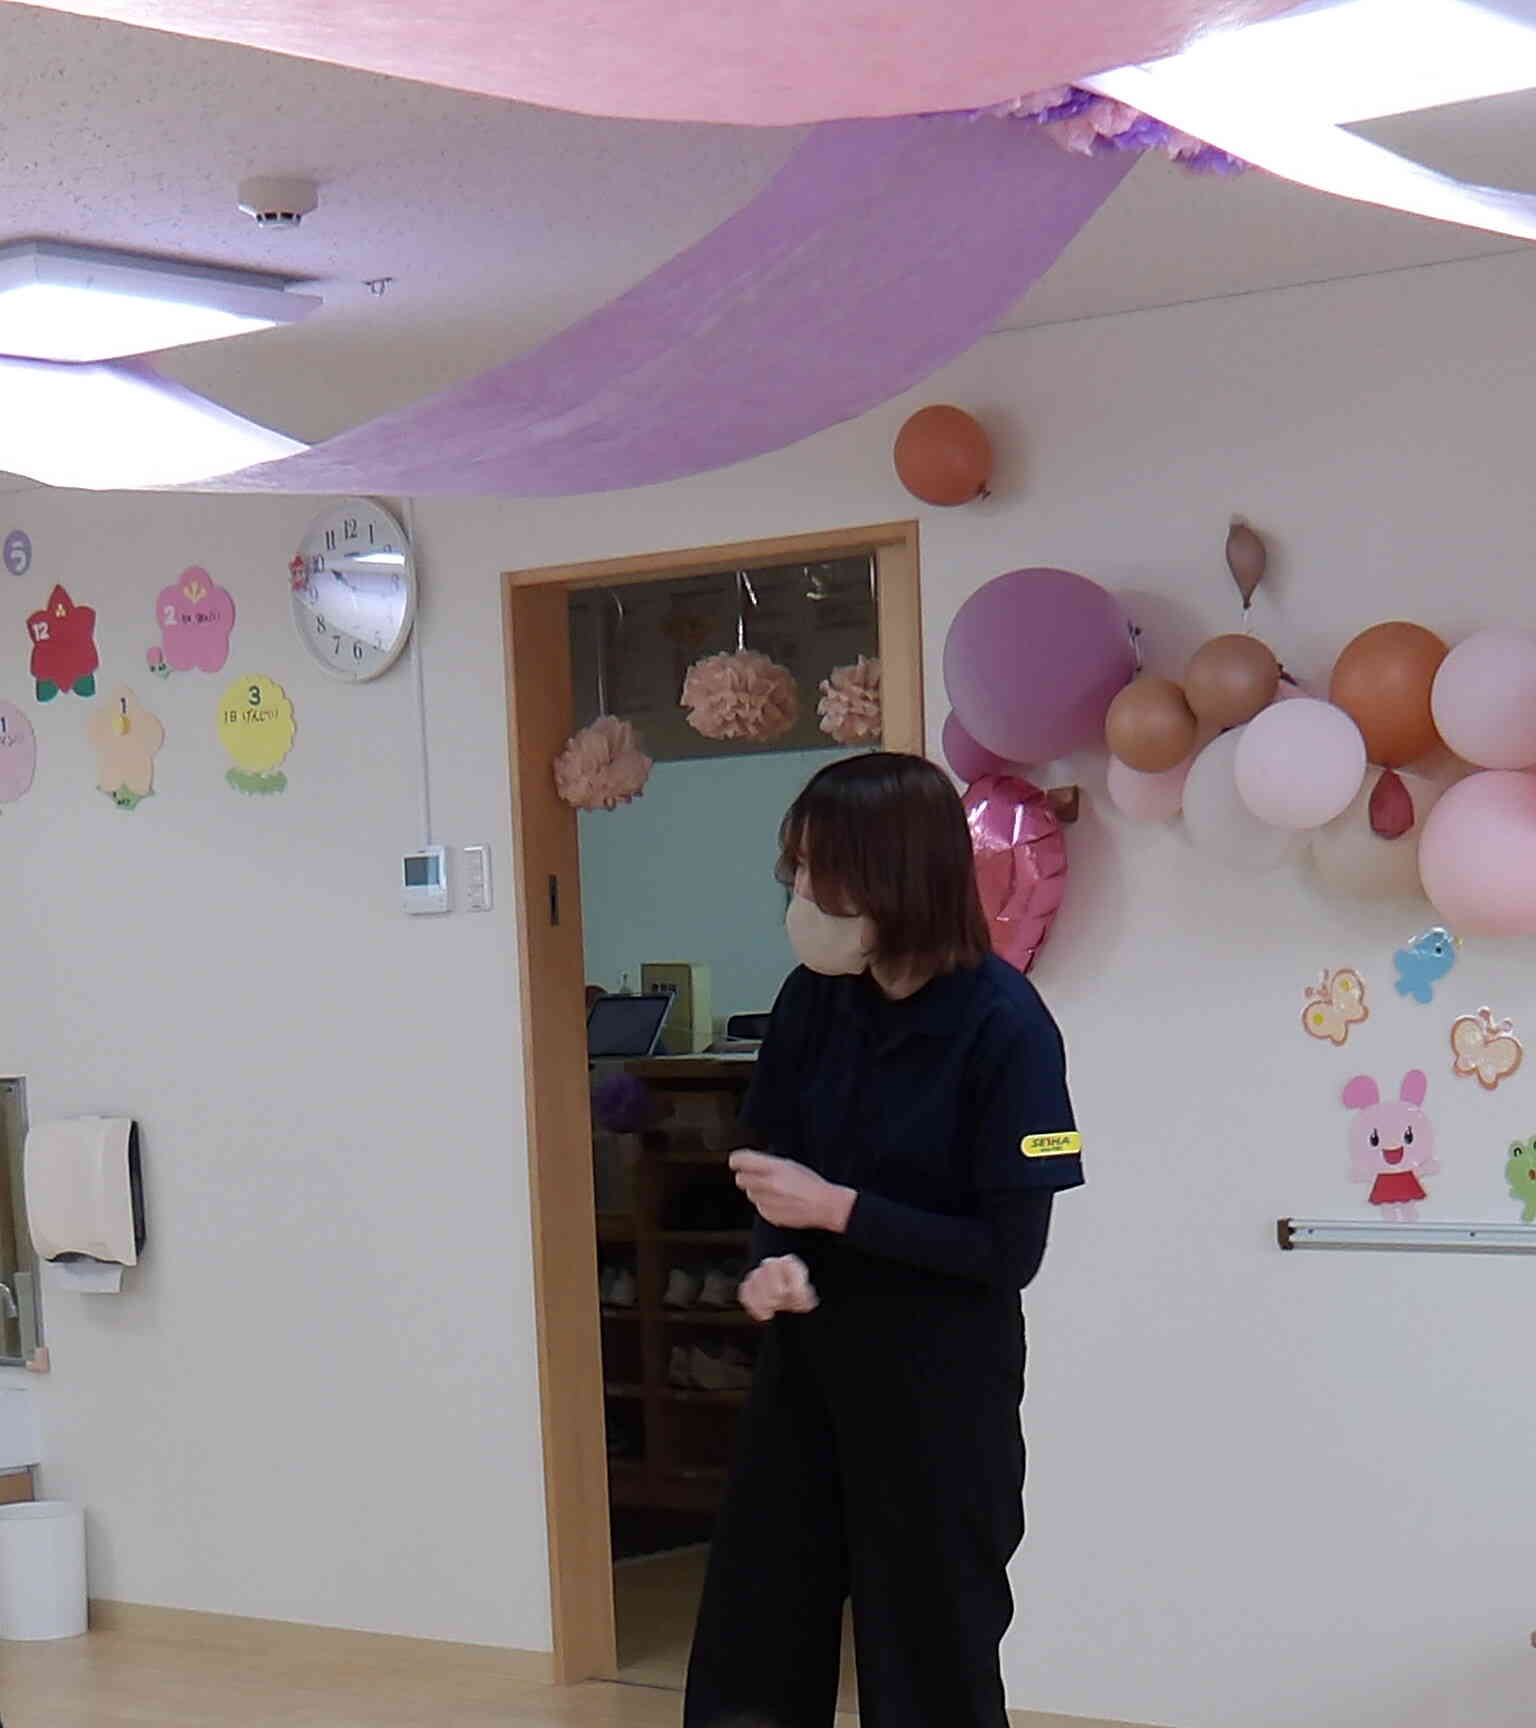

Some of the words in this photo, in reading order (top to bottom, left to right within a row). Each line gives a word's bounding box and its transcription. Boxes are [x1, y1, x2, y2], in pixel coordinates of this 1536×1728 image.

[344, 518, 358, 540] 12
[369, 523, 375, 544] 1
[325, 529, 336, 551] 11
[164, 605, 177, 625] 2
[315, 614, 327, 634] 8
[33, 621, 50, 642] 12
[332, 634, 341, 655] 7
[352, 641, 363, 660] 6
[248, 685, 261, 705] 3
